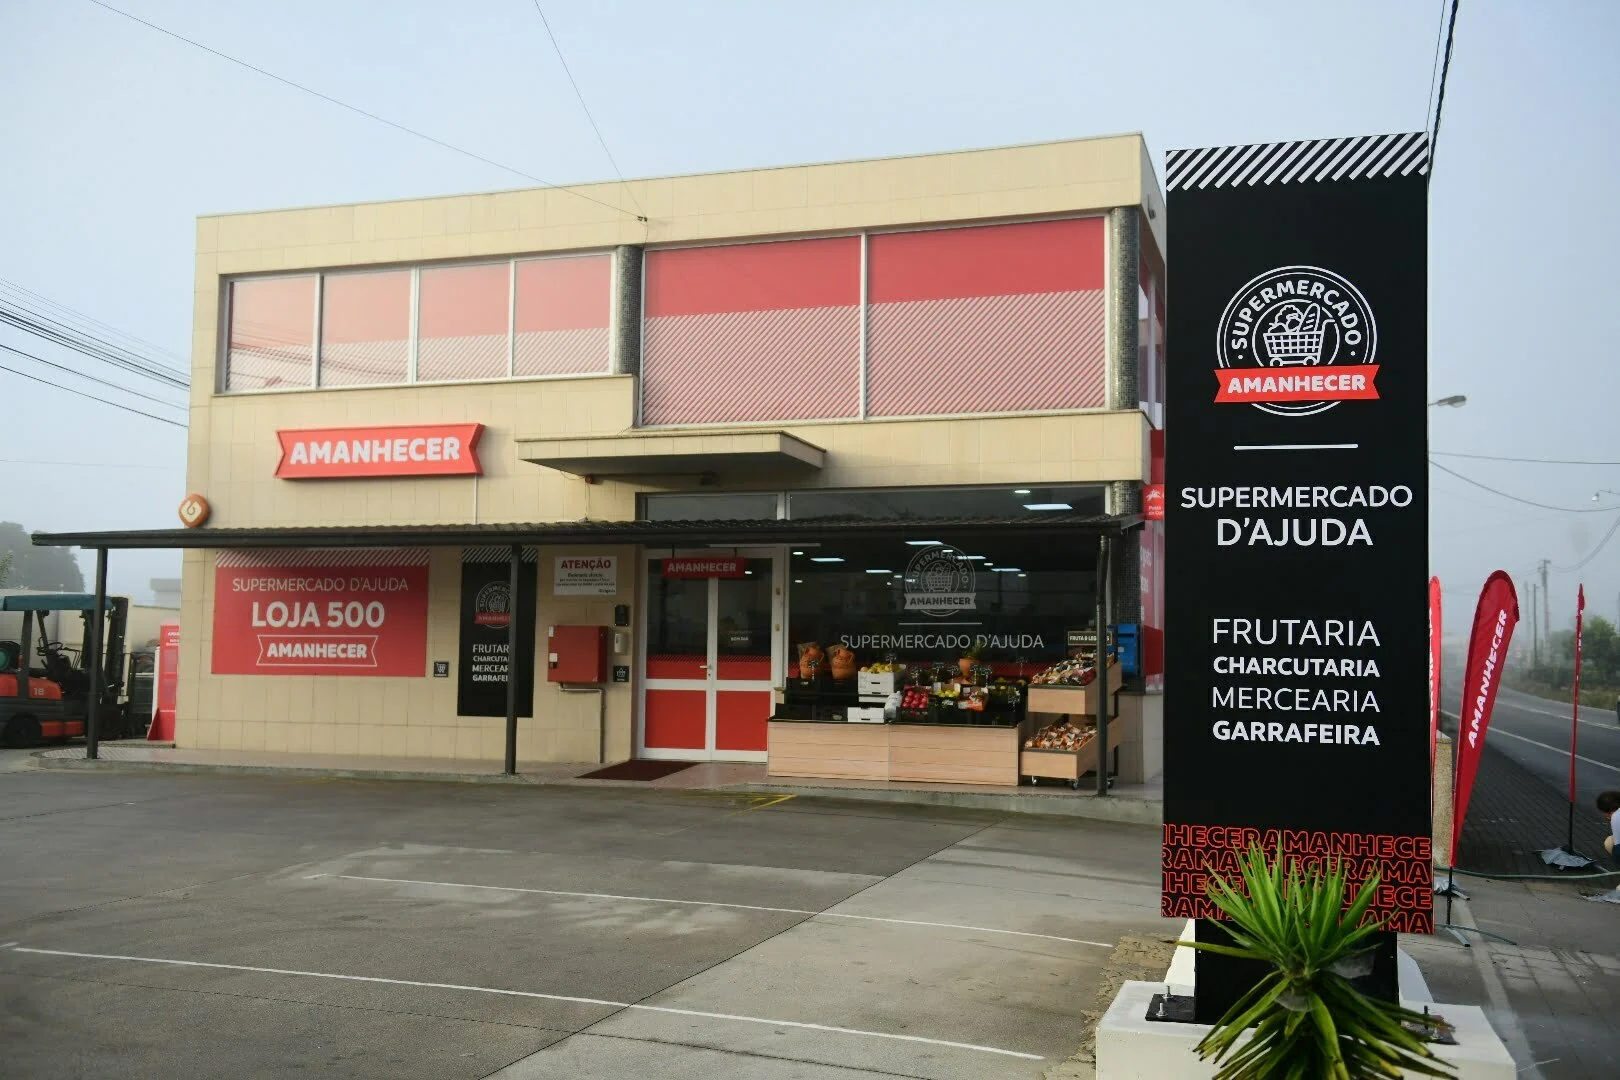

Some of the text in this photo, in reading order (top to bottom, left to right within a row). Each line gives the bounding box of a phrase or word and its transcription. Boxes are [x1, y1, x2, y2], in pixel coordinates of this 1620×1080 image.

[1231, 279, 1362, 350] SUPERMERCADO
[1227, 374, 1366, 394] AMANHECER
[290, 437, 460, 465] AMANHECER
[1180, 485, 1413, 508] SUPERMERCADO
[1217, 517, 1374, 547] D'AJUDA
[560, 557, 612, 571] ATENÇÃO
[667, 562, 737, 572] AMANHECER
[232, 578, 408, 592] SUPERMERCADO D'AJUDA
[909, 596, 971, 606] AMANHECER
[252, 601, 385, 628] LOJA 500
[840, 634, 971, 649] SUPERMERCADO
[1212, 618, 1381, 647] FRUTARIA
[267, 642, 367, 658] AMANHECER
[472, 643, 509, 653] FRUTAR
[472, 674, 508, 682] GARRAFEI
[1213, 656, 1381, 678] CHARCUTARIA
[1468, 609, 1507, 749] AMANHECER
[1212, 686, 1381, 713] MERCEARIA
[1212, 720, 1381, 746] GARRAFEIRA
